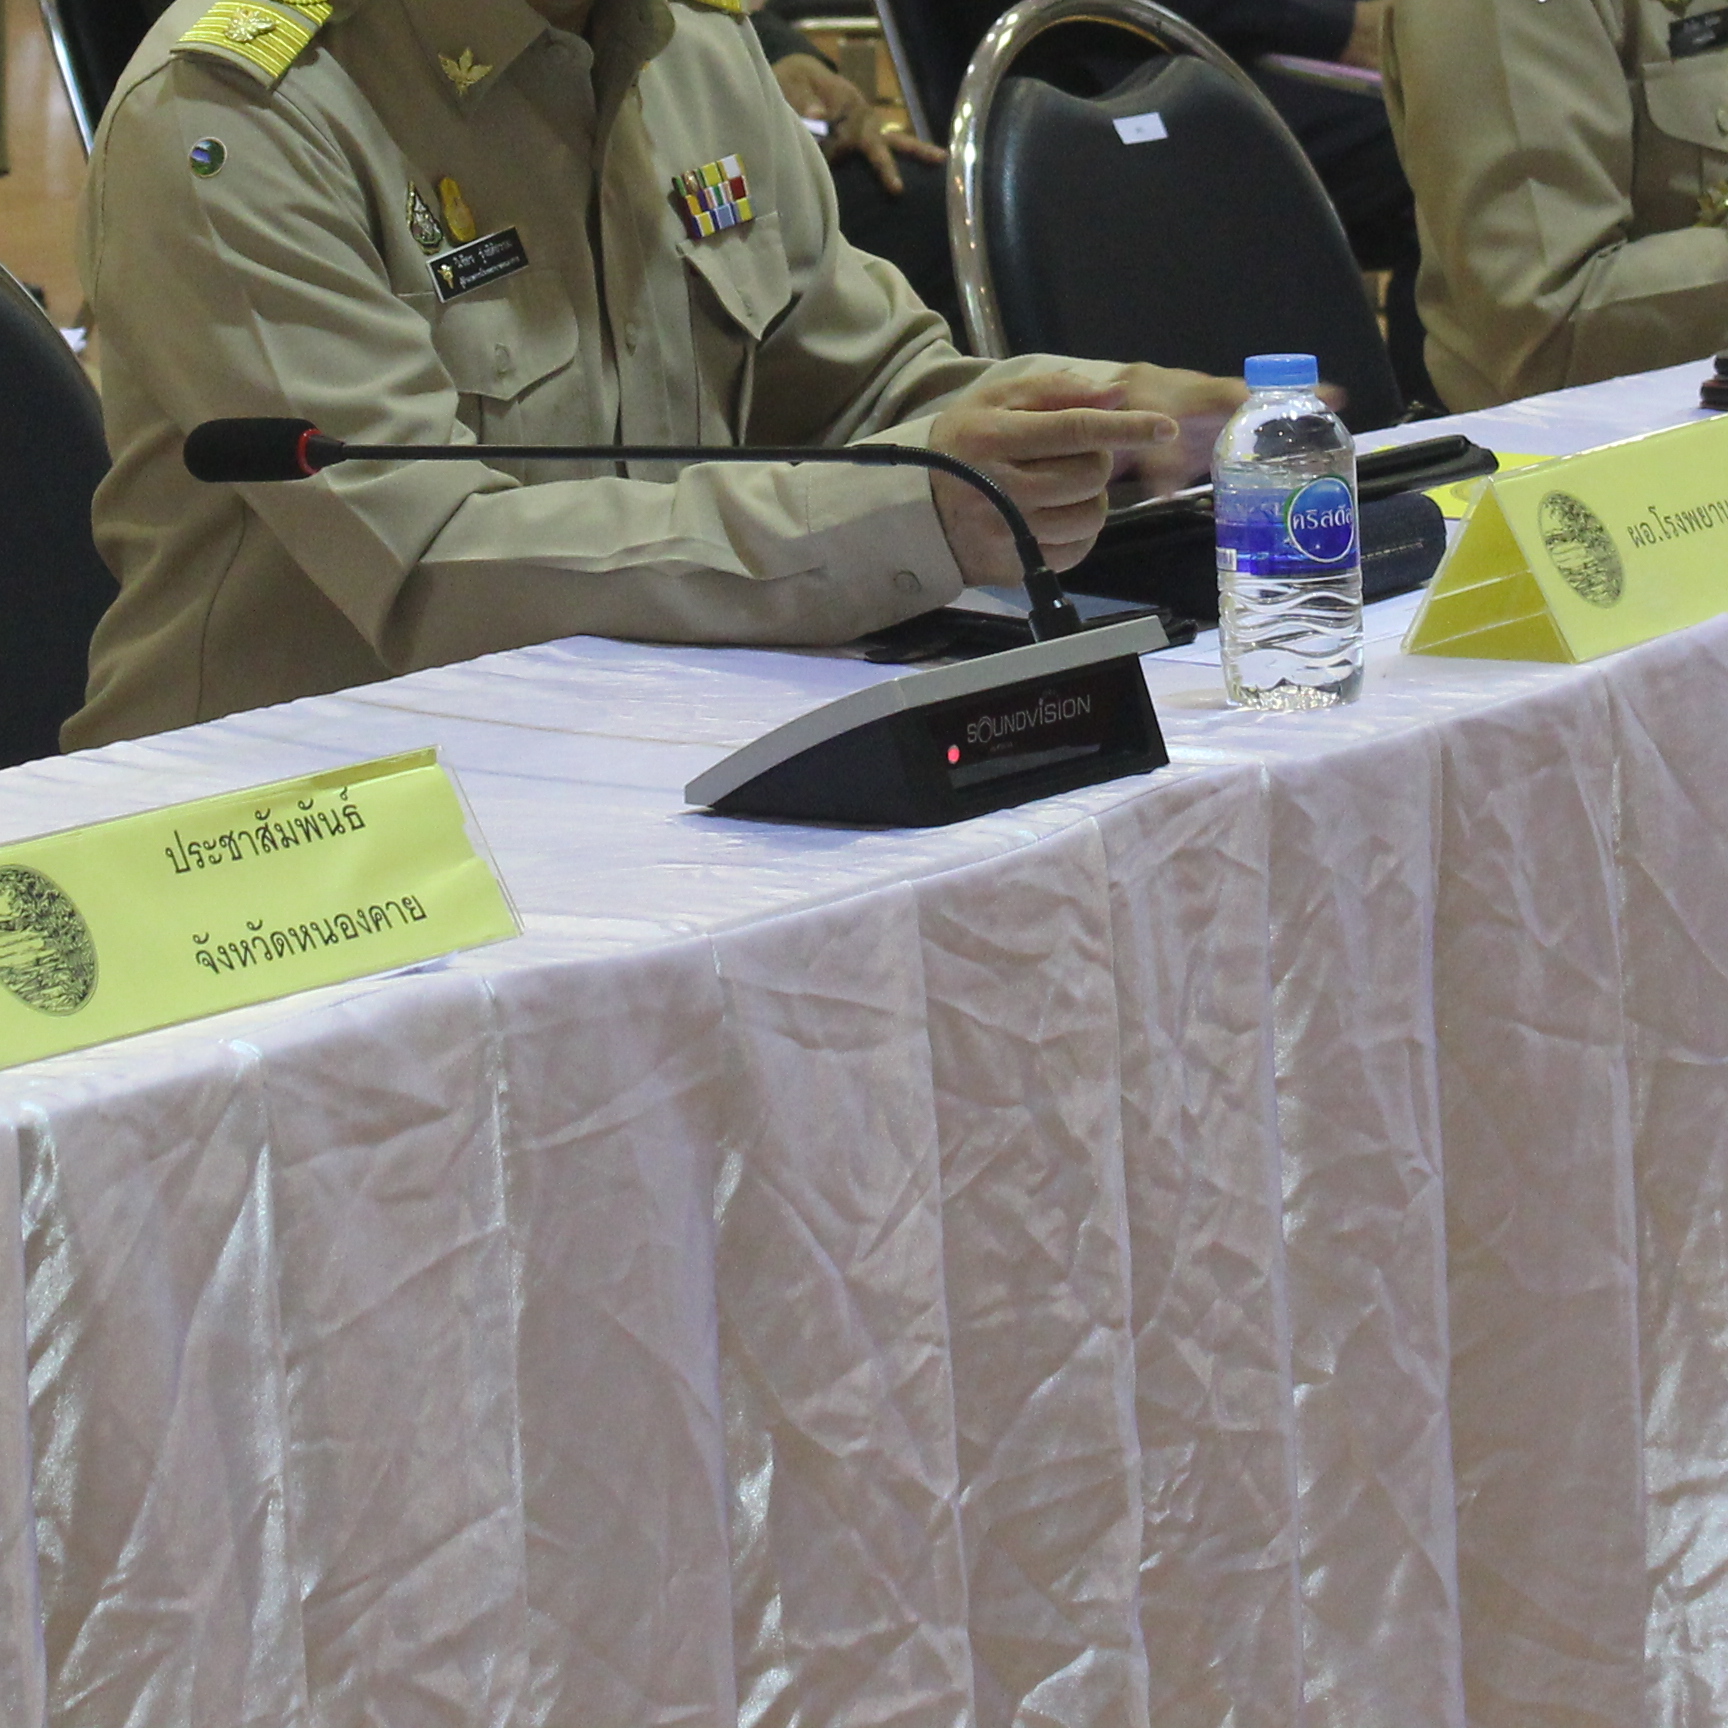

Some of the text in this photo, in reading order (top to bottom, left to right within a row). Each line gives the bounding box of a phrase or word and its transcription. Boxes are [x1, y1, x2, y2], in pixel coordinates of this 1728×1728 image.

[966, 693, 1092, 744] SOUNDVISION
[165, 785, 366, 876] ประชาสัมพันธ์
[193, 889, 428, 977] จังหวัดหนองคาย
